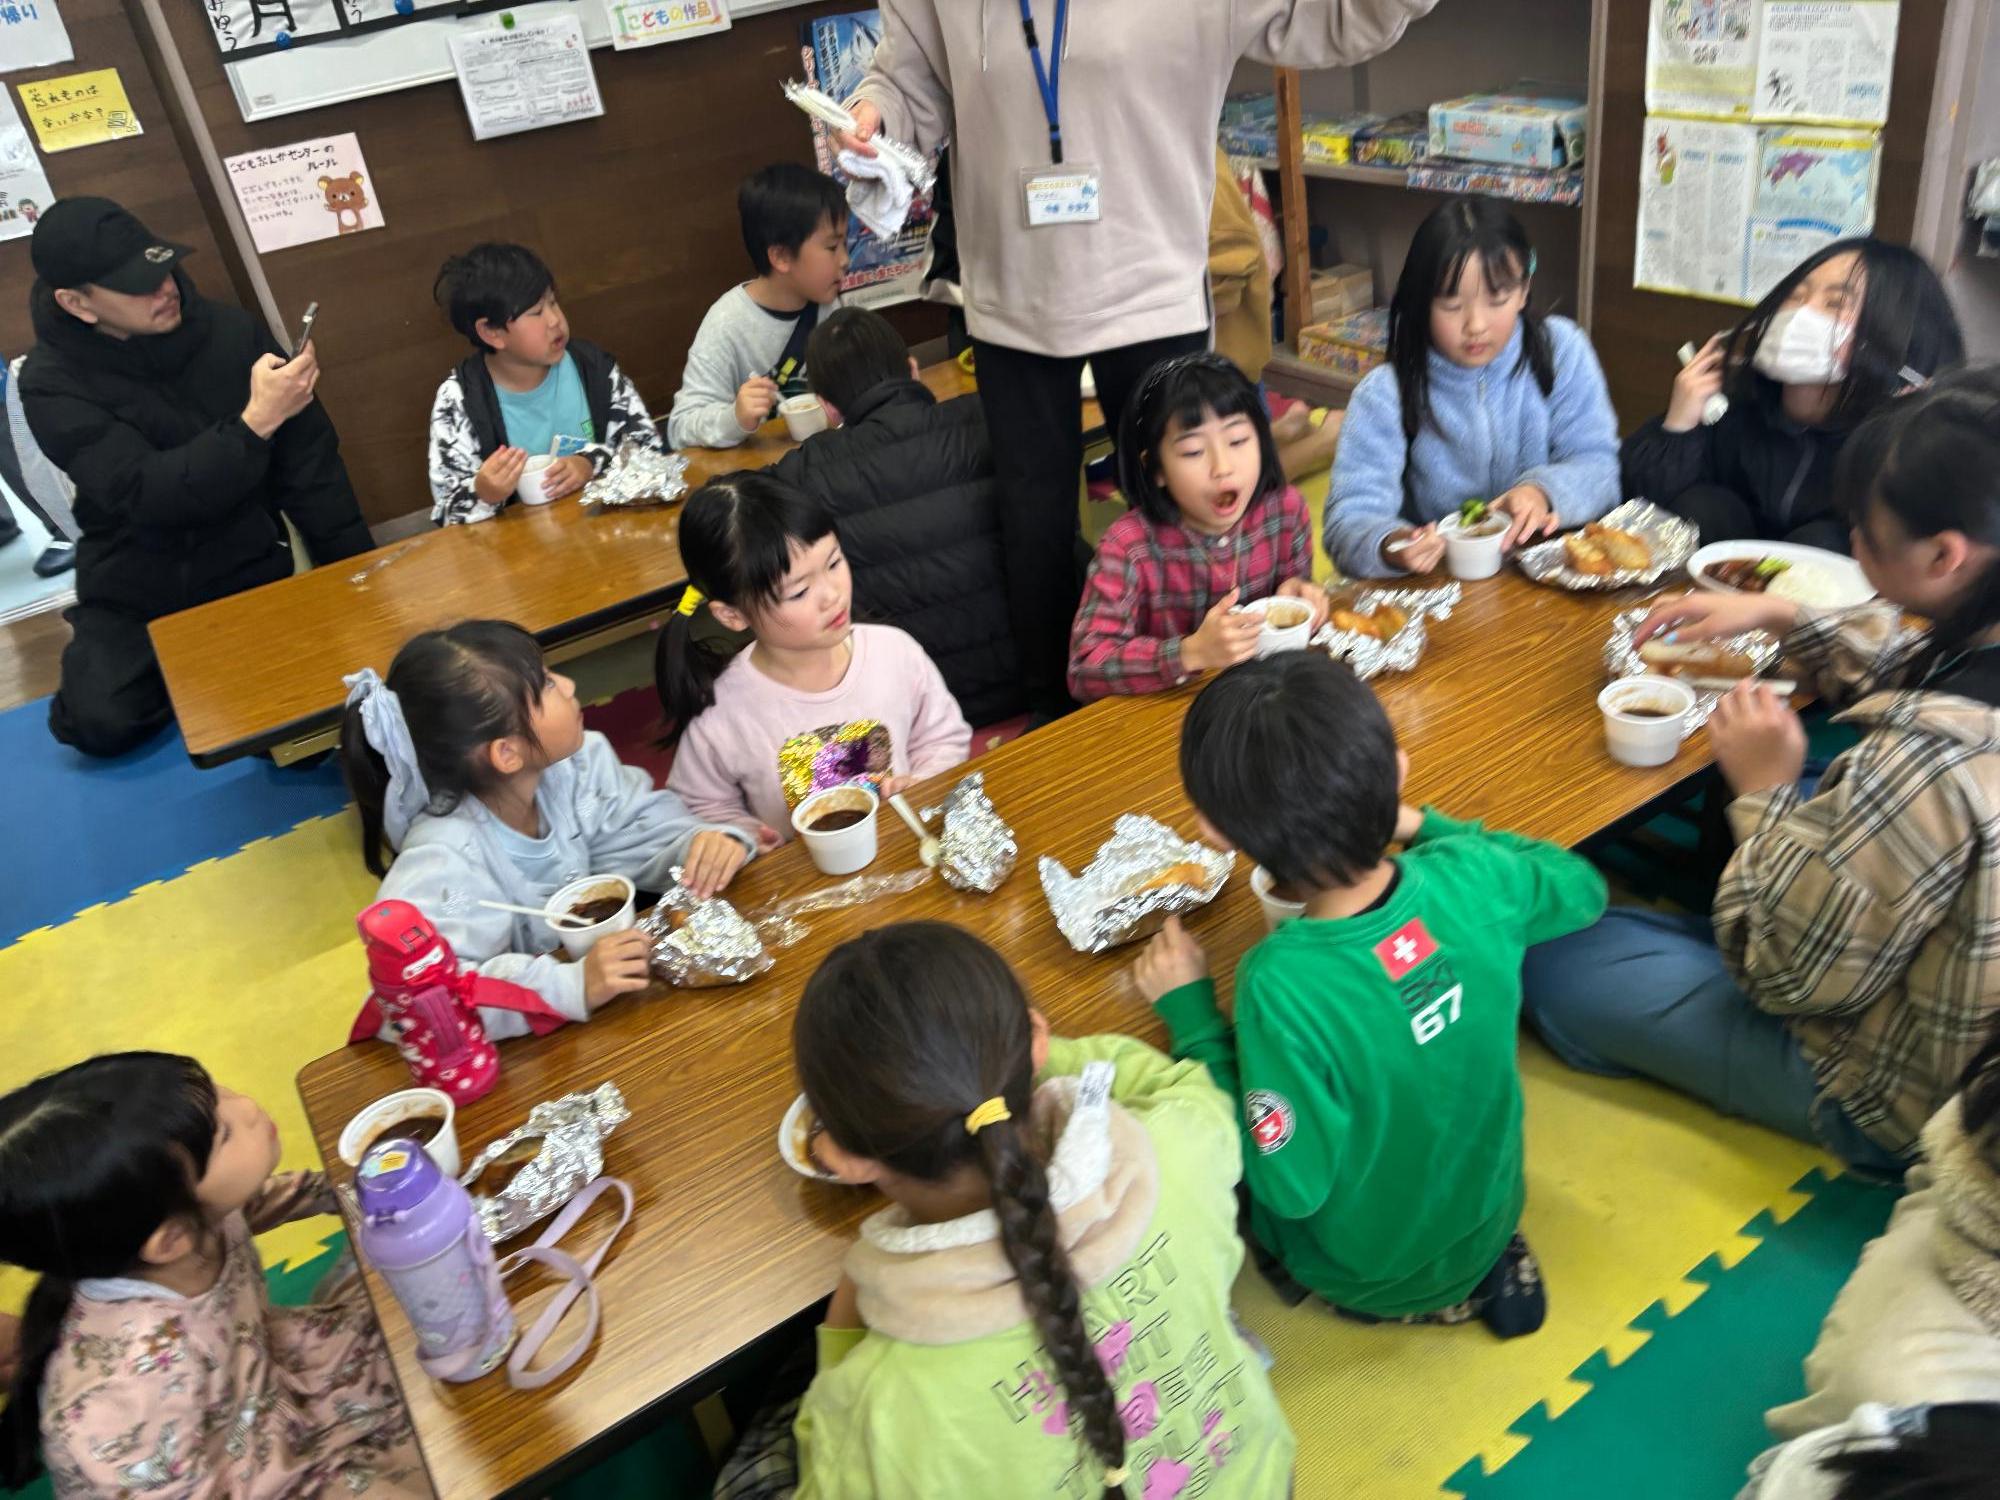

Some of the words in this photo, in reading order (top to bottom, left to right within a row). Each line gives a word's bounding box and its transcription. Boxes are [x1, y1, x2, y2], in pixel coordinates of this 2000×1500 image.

[627, 1, 711, 30] こどもの作品
[307, 158, 338, 171] ルール
[1410, 982, 1463, 1045] 67
